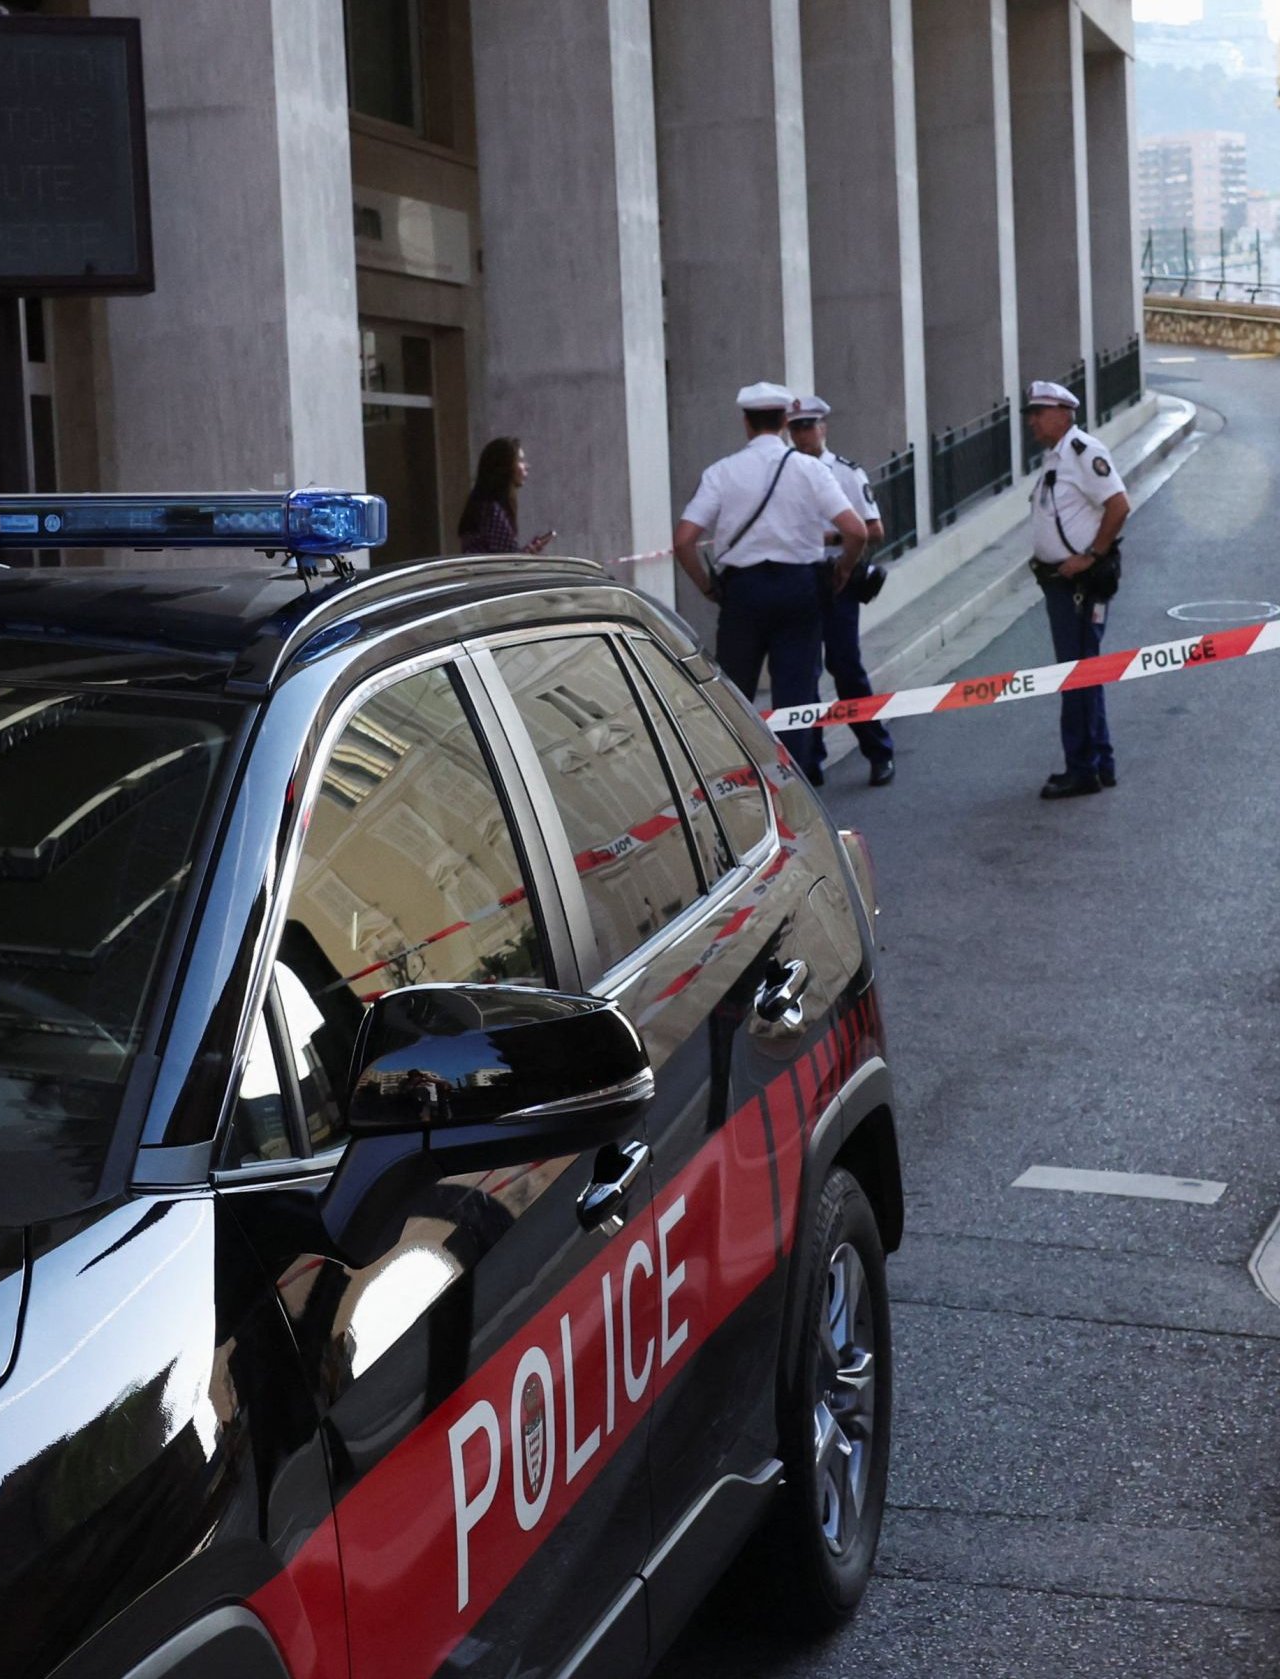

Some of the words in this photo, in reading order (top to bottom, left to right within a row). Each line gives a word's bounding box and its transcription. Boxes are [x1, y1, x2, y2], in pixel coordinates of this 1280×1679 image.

[1141, 639, 1217, 671] POLICE
[963, 674, 1036, 703] POLICE
[788, 702, 859, 726] POLICE
[448, 1195, 689, 1613] POLICE
